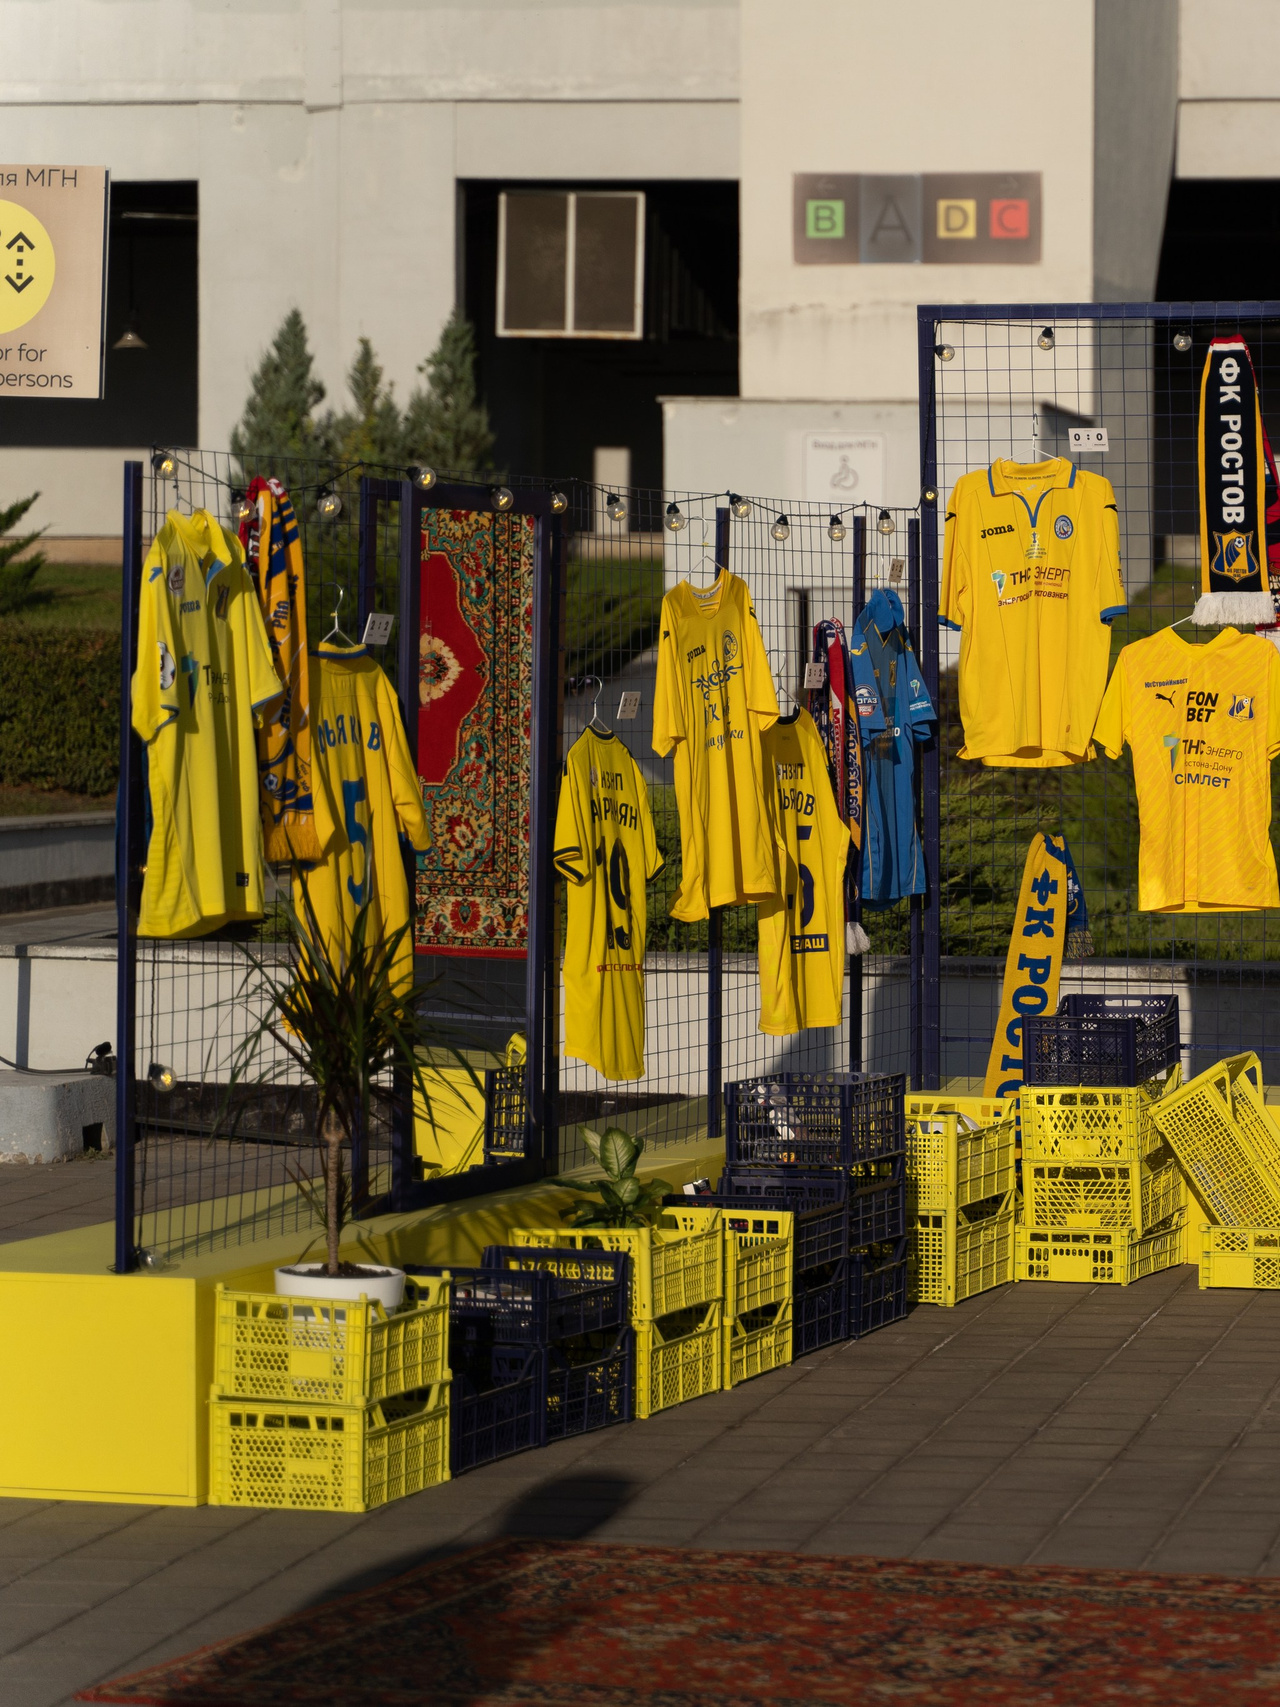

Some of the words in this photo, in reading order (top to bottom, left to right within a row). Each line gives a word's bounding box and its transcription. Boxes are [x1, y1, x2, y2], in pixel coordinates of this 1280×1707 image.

[26, 169, 78, 188] МГН
[813, 204, 837, 233] B
[869, 194, 913, 243] A
[945, 204, 969, 233] D
[999, 204, 1020, 233] C
[18, 343, 47, 361] for
[1219, 357, 1241, 403] ФК
[1220, 414, 1245, 524] РОСТОВ
[1186, 691, 1219, 707] FON
[1186, 708, 1216, 722] BET
[1206, 746, 1243, 760] ЭНЕРГО
[1022, 868, 1058, 938] ФК
